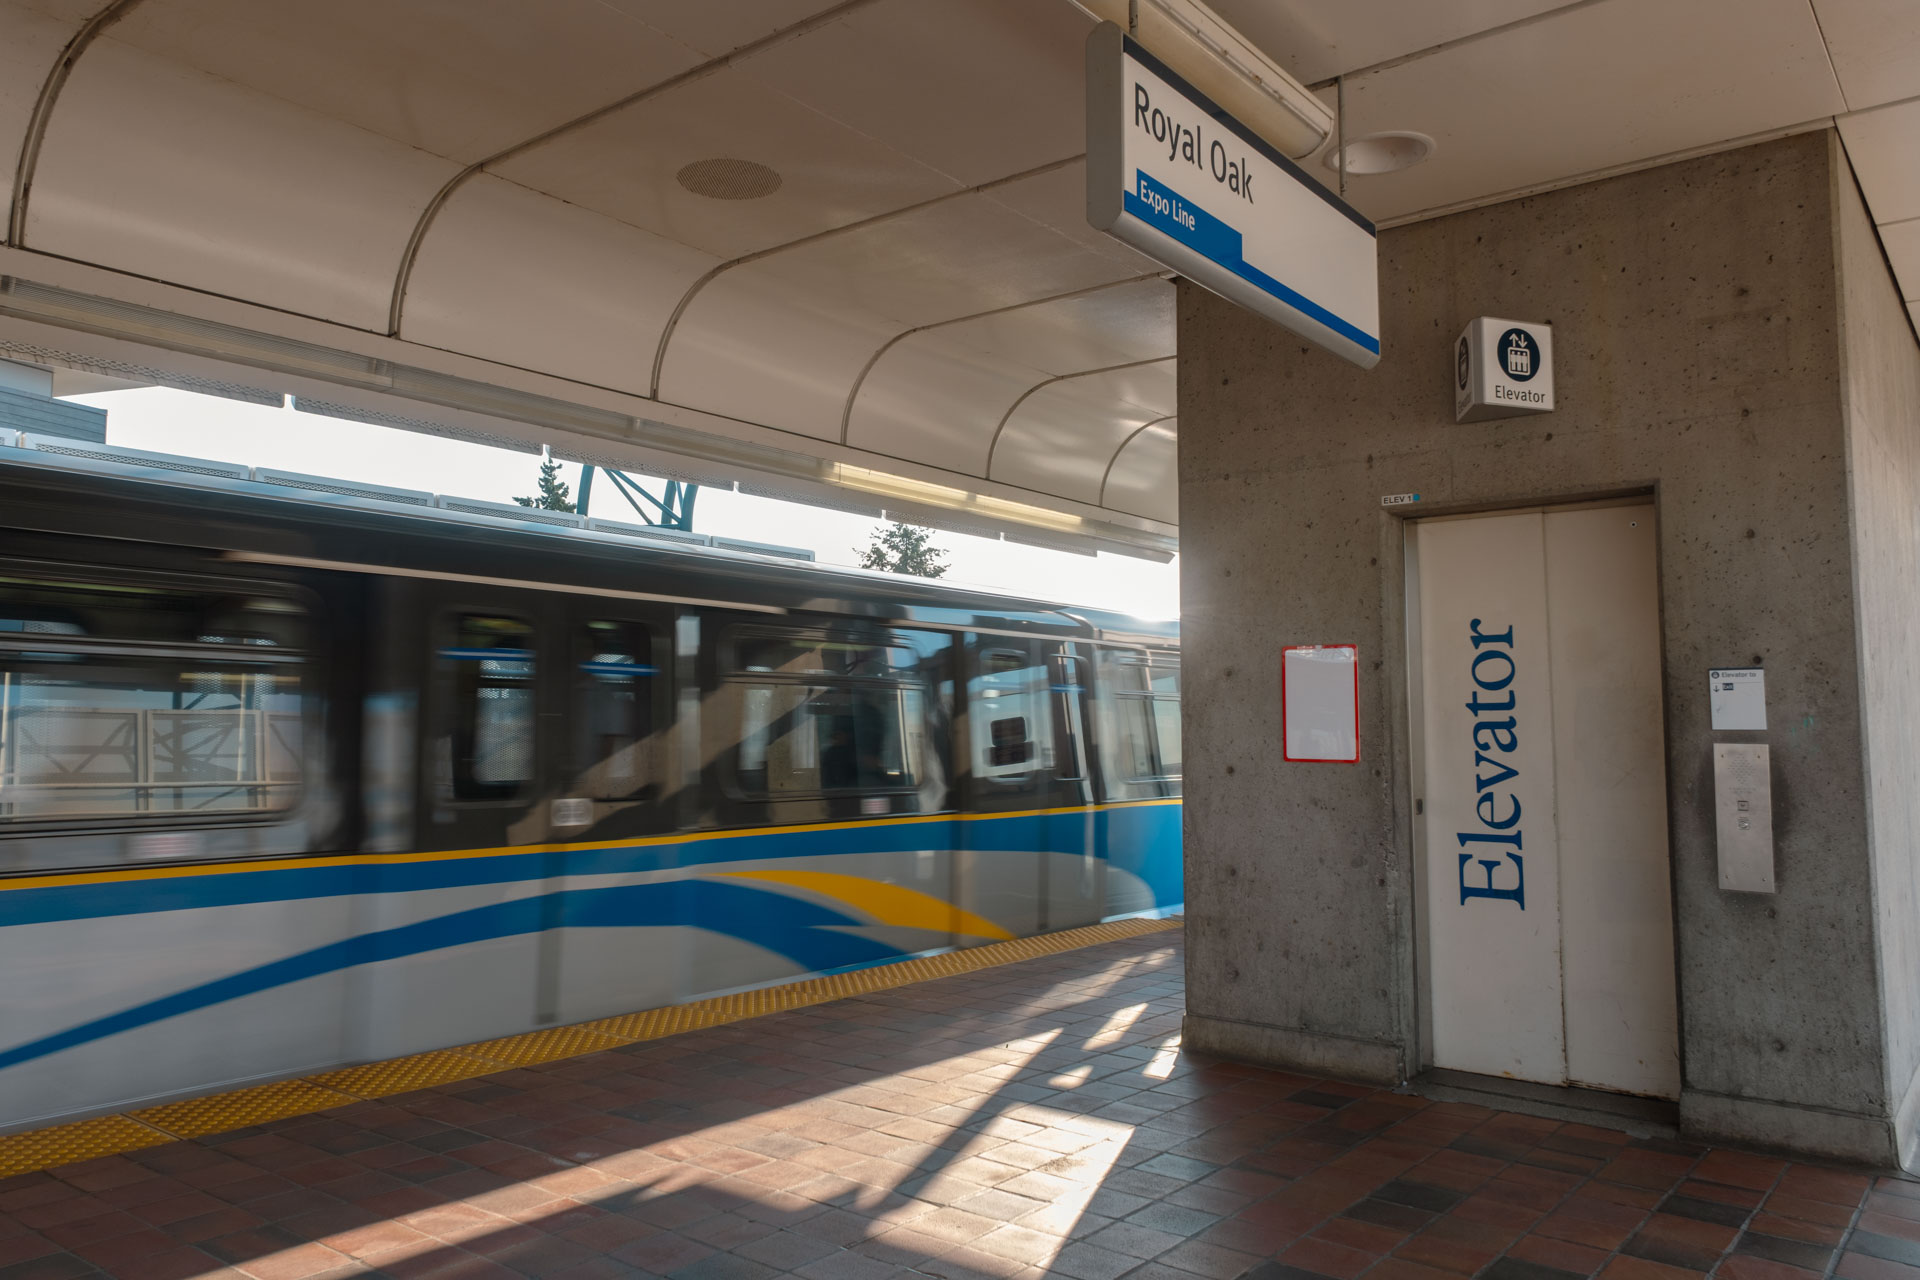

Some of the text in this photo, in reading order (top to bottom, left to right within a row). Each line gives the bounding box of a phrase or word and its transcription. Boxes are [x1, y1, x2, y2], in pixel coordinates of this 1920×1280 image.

[1135, 82, 1254, 204] Royal Oak
[1140, 180, 1196, 231] Expo Line
[1495, 385, 1546, 403] Elevator
[1383, 496, 1405, 504] ELEV
[1456, 618, 1525, 911] Elevator
